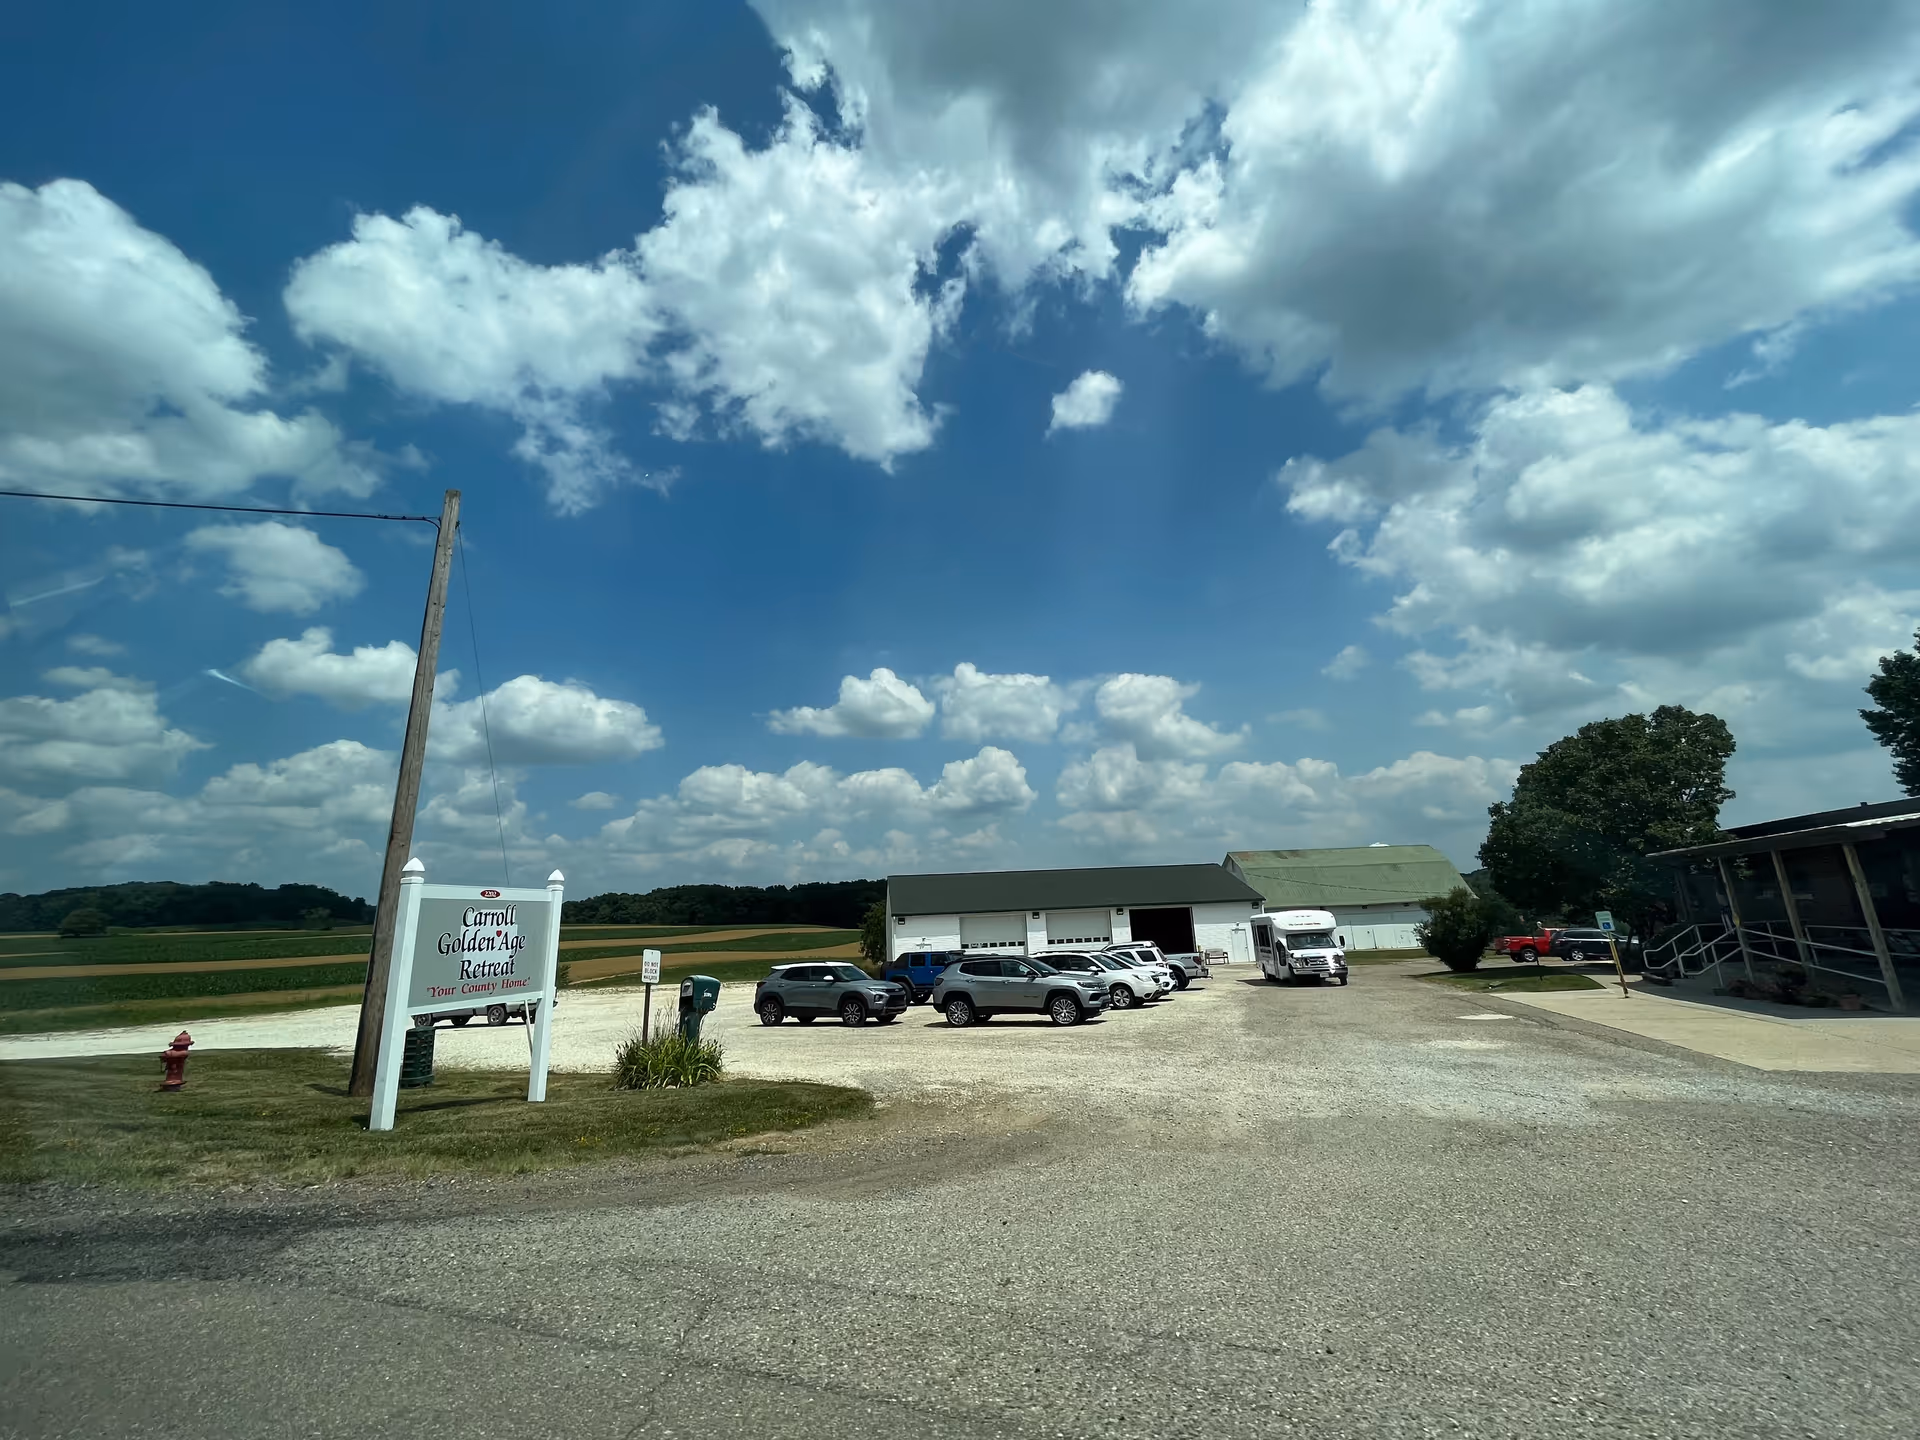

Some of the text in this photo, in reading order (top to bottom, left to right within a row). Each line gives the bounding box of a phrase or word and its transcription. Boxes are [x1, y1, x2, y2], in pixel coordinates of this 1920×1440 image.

[462, 904, 516, 928] Carroll
[437, 928, 526, 959] Golden Age
[458, 958, 516, 981] Retreat
[461, 981, 498, 996] County
